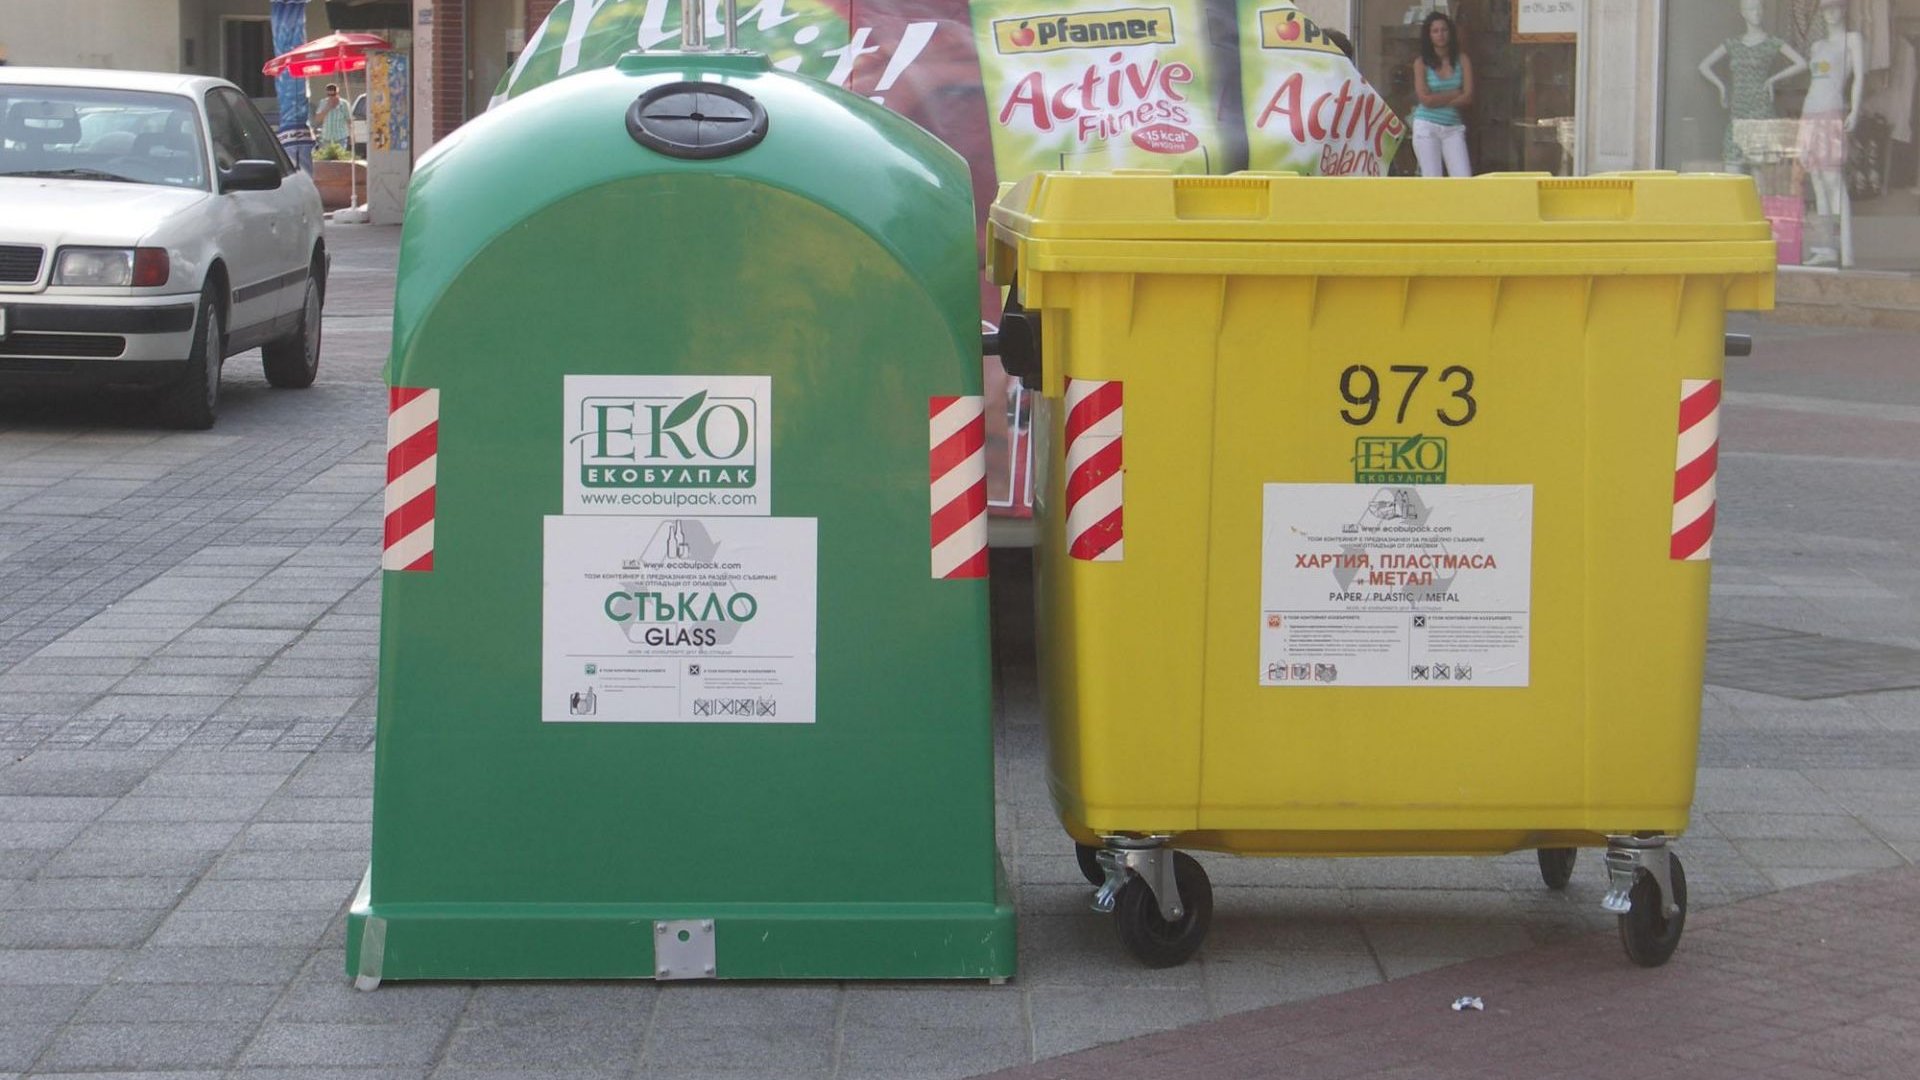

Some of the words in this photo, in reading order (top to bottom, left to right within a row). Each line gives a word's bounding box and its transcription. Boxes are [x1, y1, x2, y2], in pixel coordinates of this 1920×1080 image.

[1037, 17, 1158, 45] Pfanner
[999, 51, 1193, 130] Active
[1078, 99, 1189, 141] Fitness
[1339, 365, 1477, 426] 973
[589, 390, 749, 462] ЕКО
[588, 468, 749, 483] ЕКОБУЛПАК
[581, 491, 757, 508] www.ecobulpack.com
[1361, 525, 1452, 534] www.ecobulpack.com
[643, 560, 742, 571] www.ecobulpack.com
[1295, 554, 1374, 570] ХАРТИЯ,
[1380, 554, 1497, 569] ПЛАСТМАСА
[1369, 571, 1432, 586] МЕТАЛ
[1329, 592, 1362, 602] PAPER
[1373, 592, 1414, 602] PLASTIC
[1426, 592, 1460, 602] METAL
[604, 591, 758, 622] СТЪКЛО
[645, 627, 716, 647] GLASS
